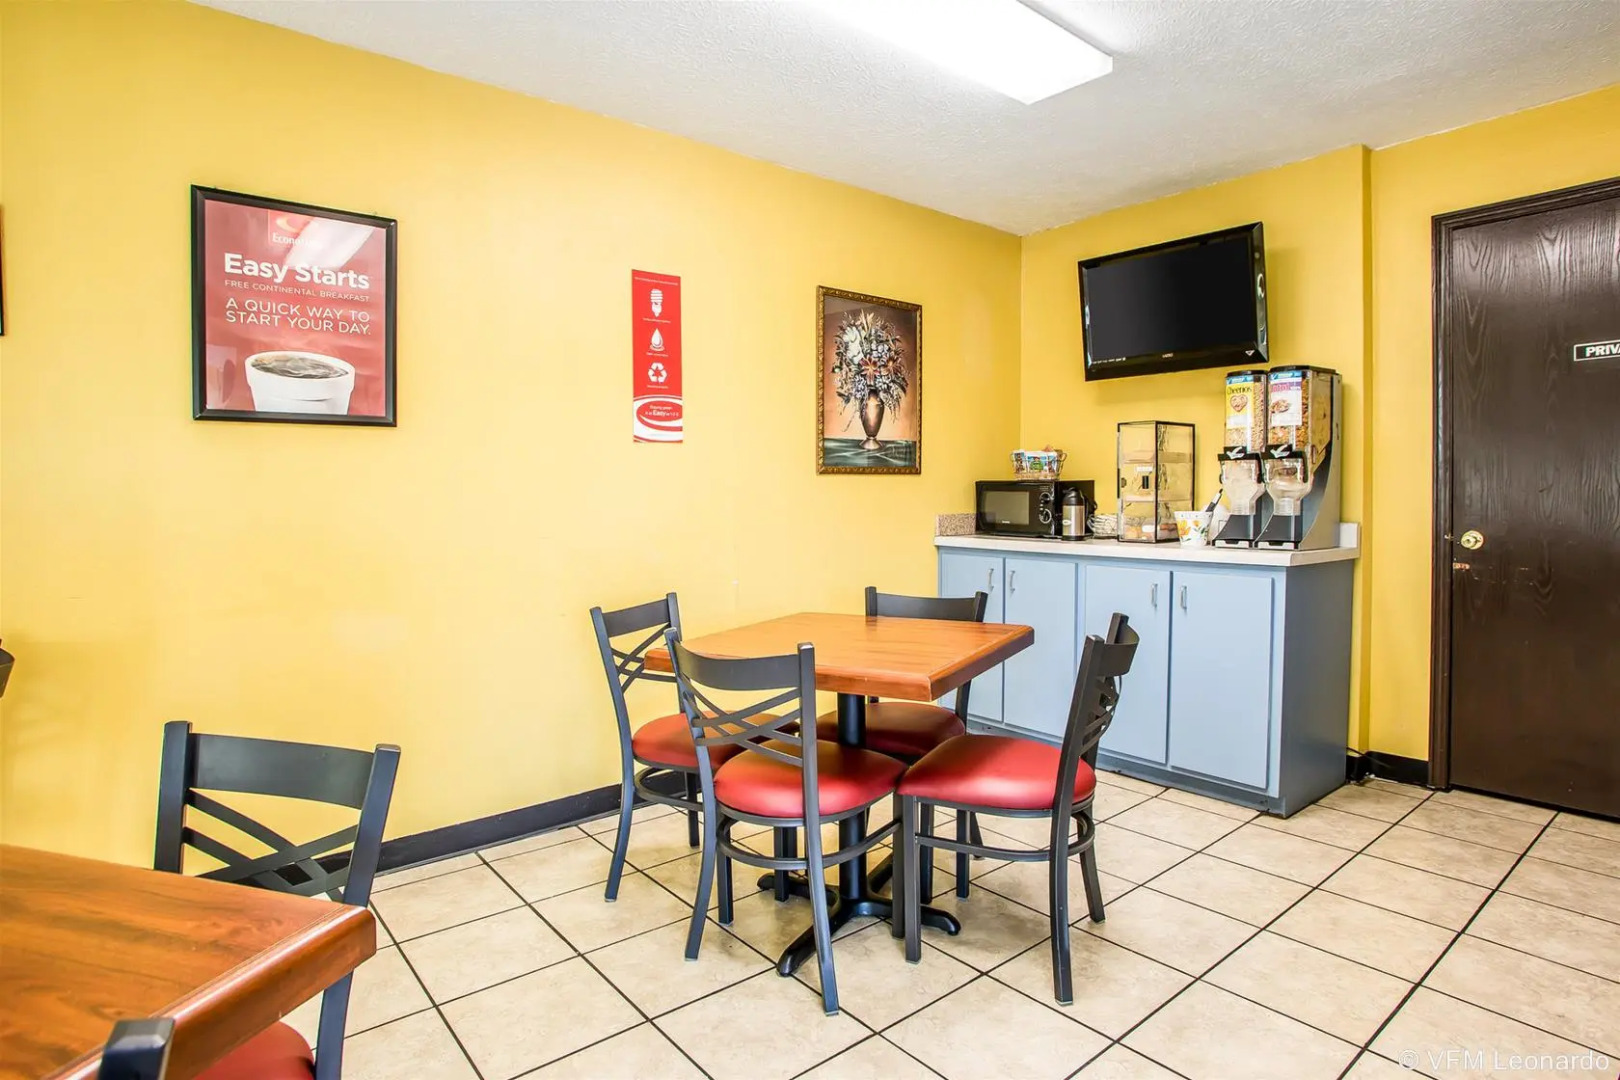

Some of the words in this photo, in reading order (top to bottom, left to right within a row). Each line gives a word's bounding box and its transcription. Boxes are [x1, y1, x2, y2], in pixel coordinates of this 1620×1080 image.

[224, 252, 289, 284] Easy
[294, 261, 370, 290] Starts
[224, 279, 249, 289] FREE
[252, 282, 317, 297] CONTINENTAL
[319, 290, 370, 302] BREAKFAST
[225, 297, 239, 310] A
[244, 299, 301, 316] QUICK
[306, 305, 343, 320] WAY
[349, 309, 370, 323] TO
[225, 310, 281, 327] START
[287, 316, 334, 332] YOUR
[338, 321, 371, 335] DAY.
[1585, 343, 1620, 357] PRIV
